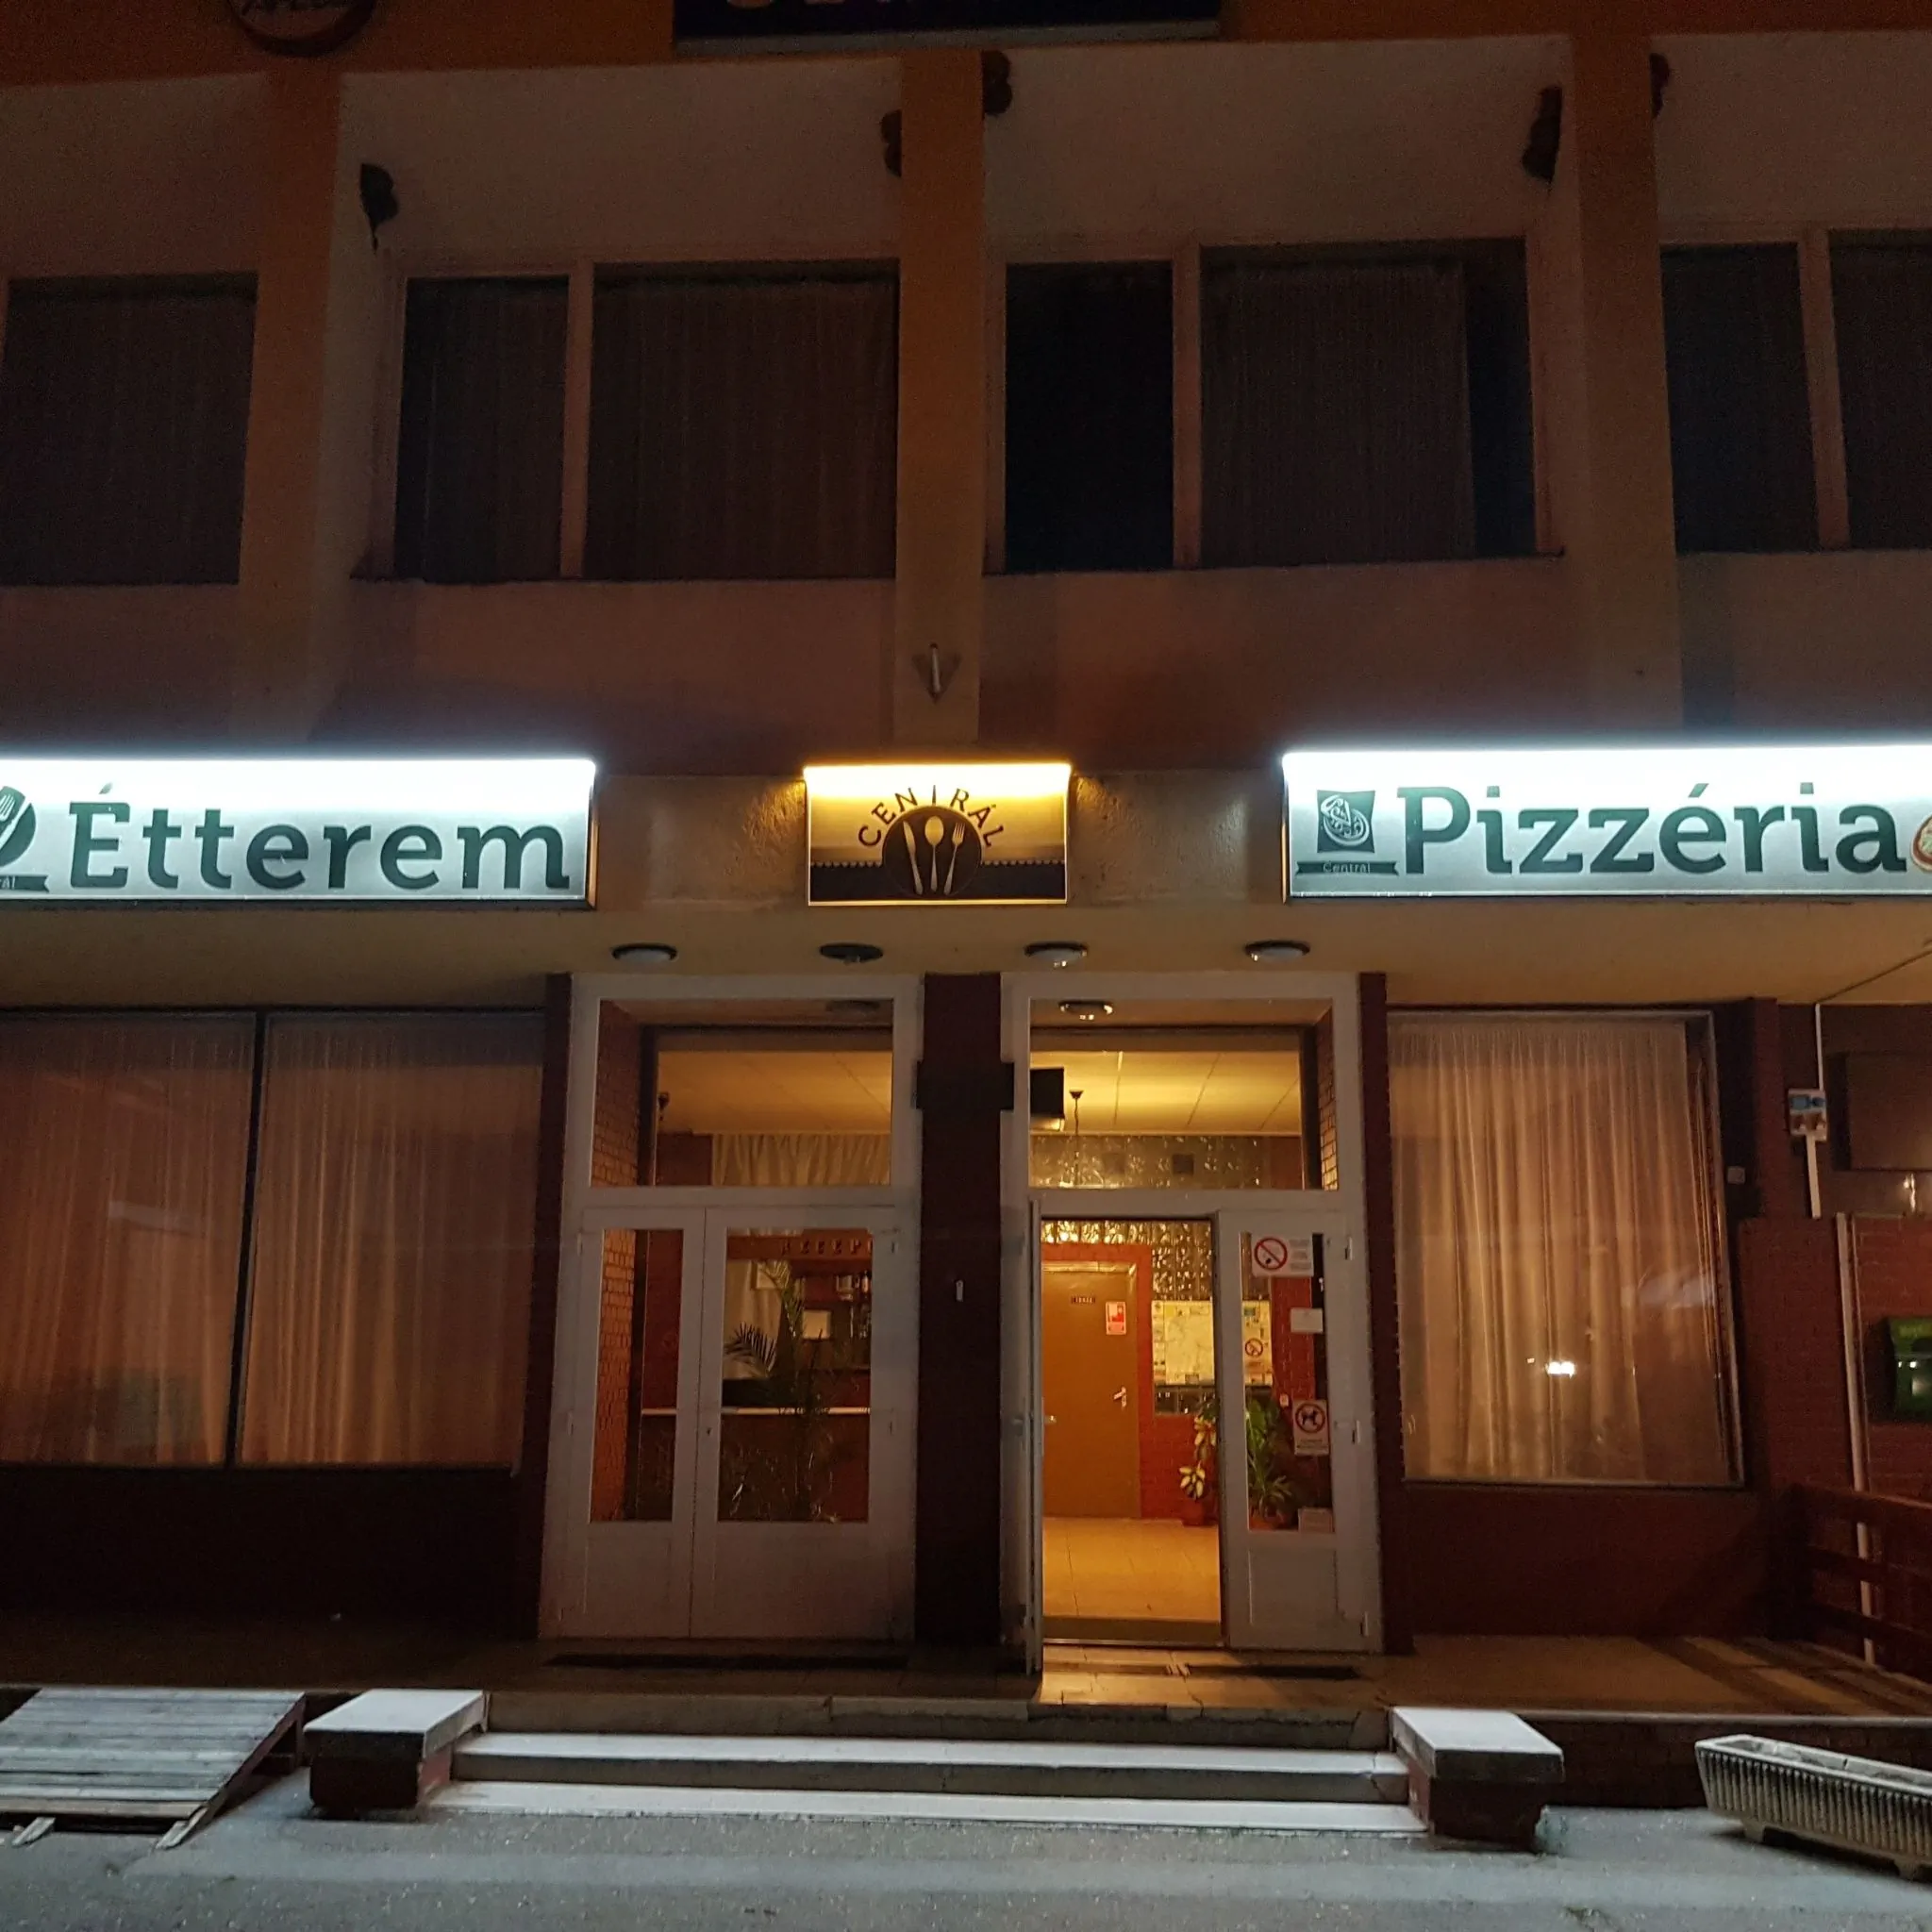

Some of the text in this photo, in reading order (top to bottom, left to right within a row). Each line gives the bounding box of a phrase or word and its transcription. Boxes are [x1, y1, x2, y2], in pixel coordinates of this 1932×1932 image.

[69, 782, 571, 891] Étterem
[1323, 862, 1371, 874] Central
[1395, 782, 1907, 875] Pizzéria
